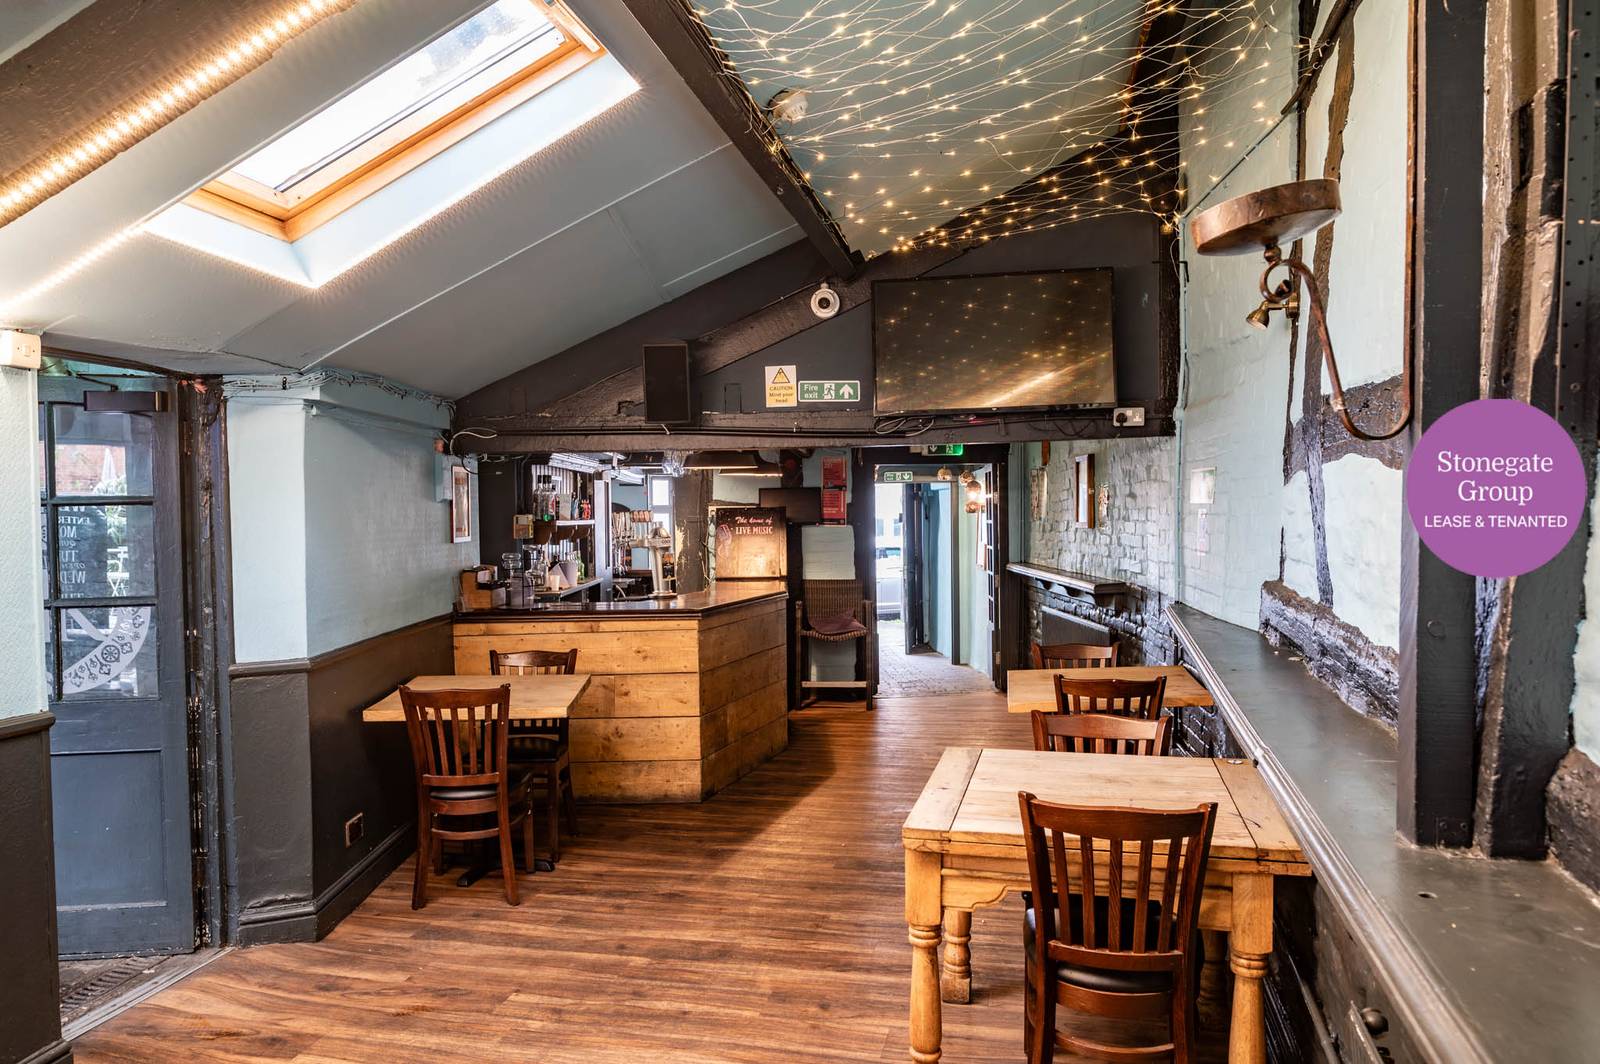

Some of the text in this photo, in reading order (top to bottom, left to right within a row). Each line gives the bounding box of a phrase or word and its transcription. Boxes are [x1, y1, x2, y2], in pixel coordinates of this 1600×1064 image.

[735, 516, 748, 524] The
[765, 515, 773, 525] of
[735, 526, 773, 534] LIVE MUSIC
